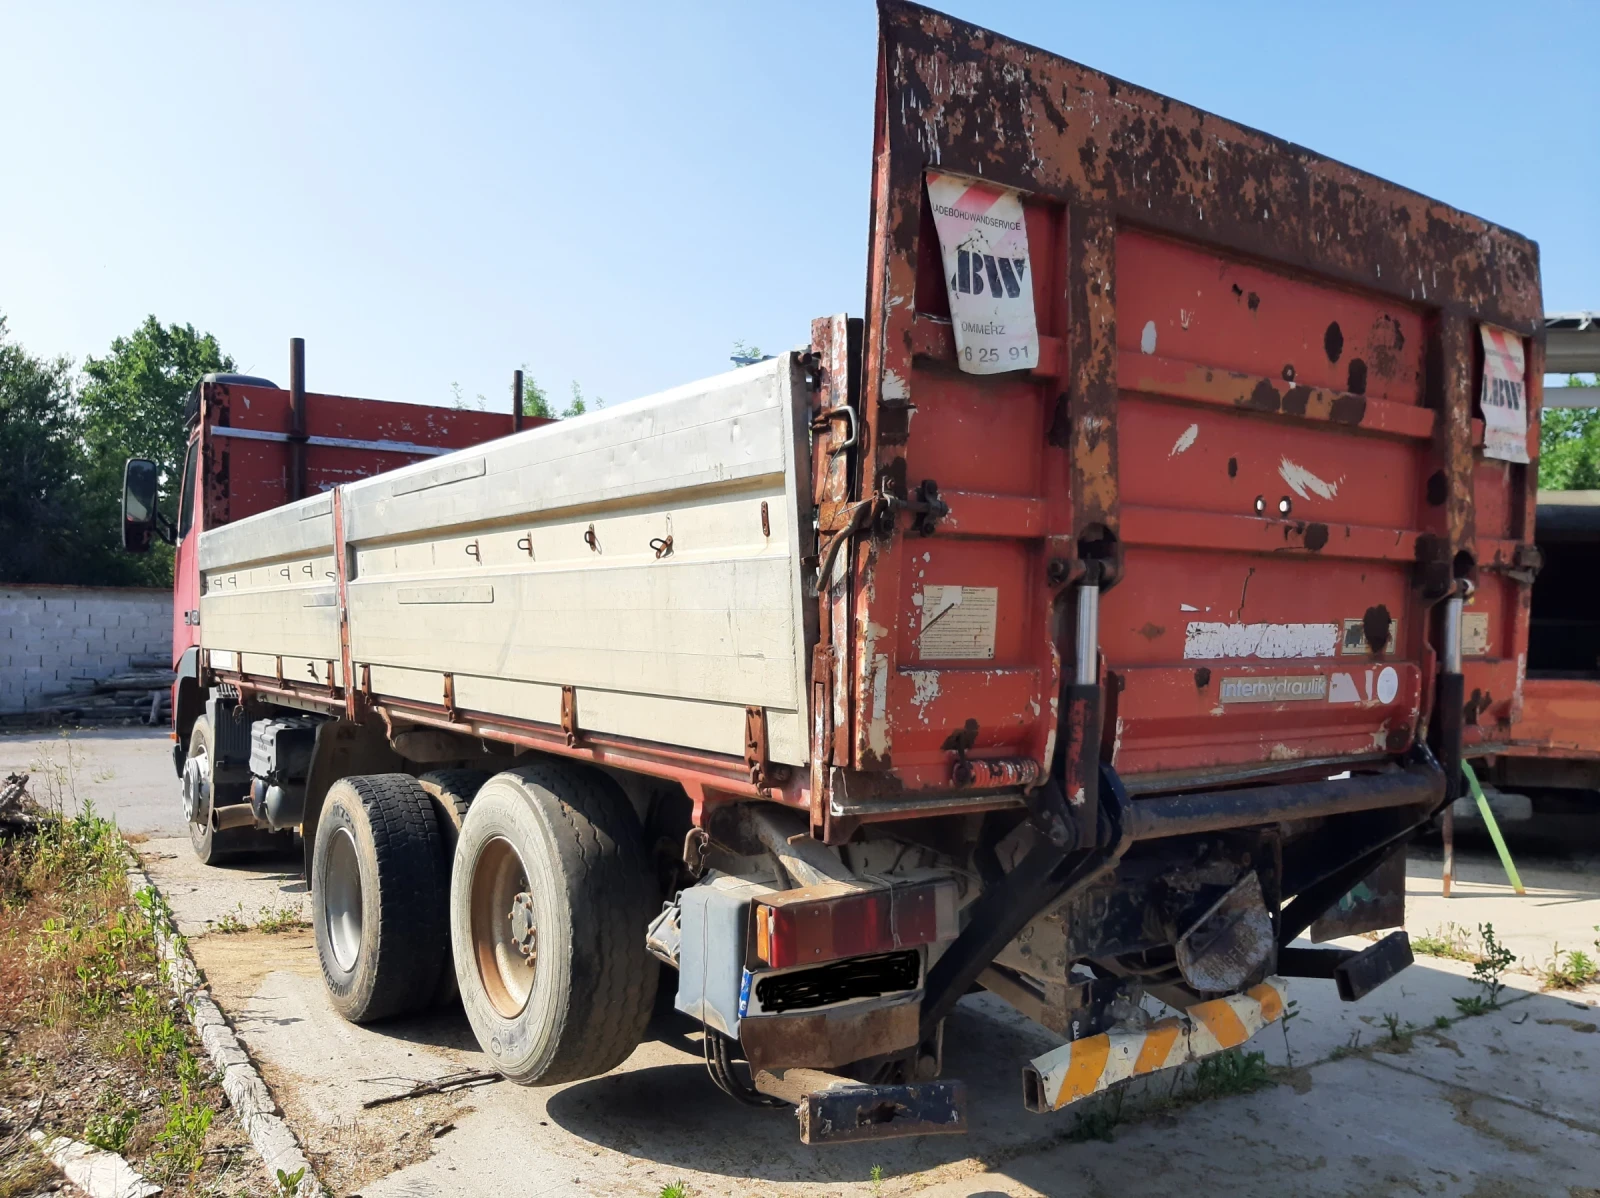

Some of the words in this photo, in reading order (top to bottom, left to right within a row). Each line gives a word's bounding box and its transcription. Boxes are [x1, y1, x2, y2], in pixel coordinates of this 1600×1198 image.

[951, 249, 1027, 299] BW
[978, 348, 1000, 363] 25
[1008, 346, 1029, 360] 91
[1222, 677, 1327, 698] interhydraulik
